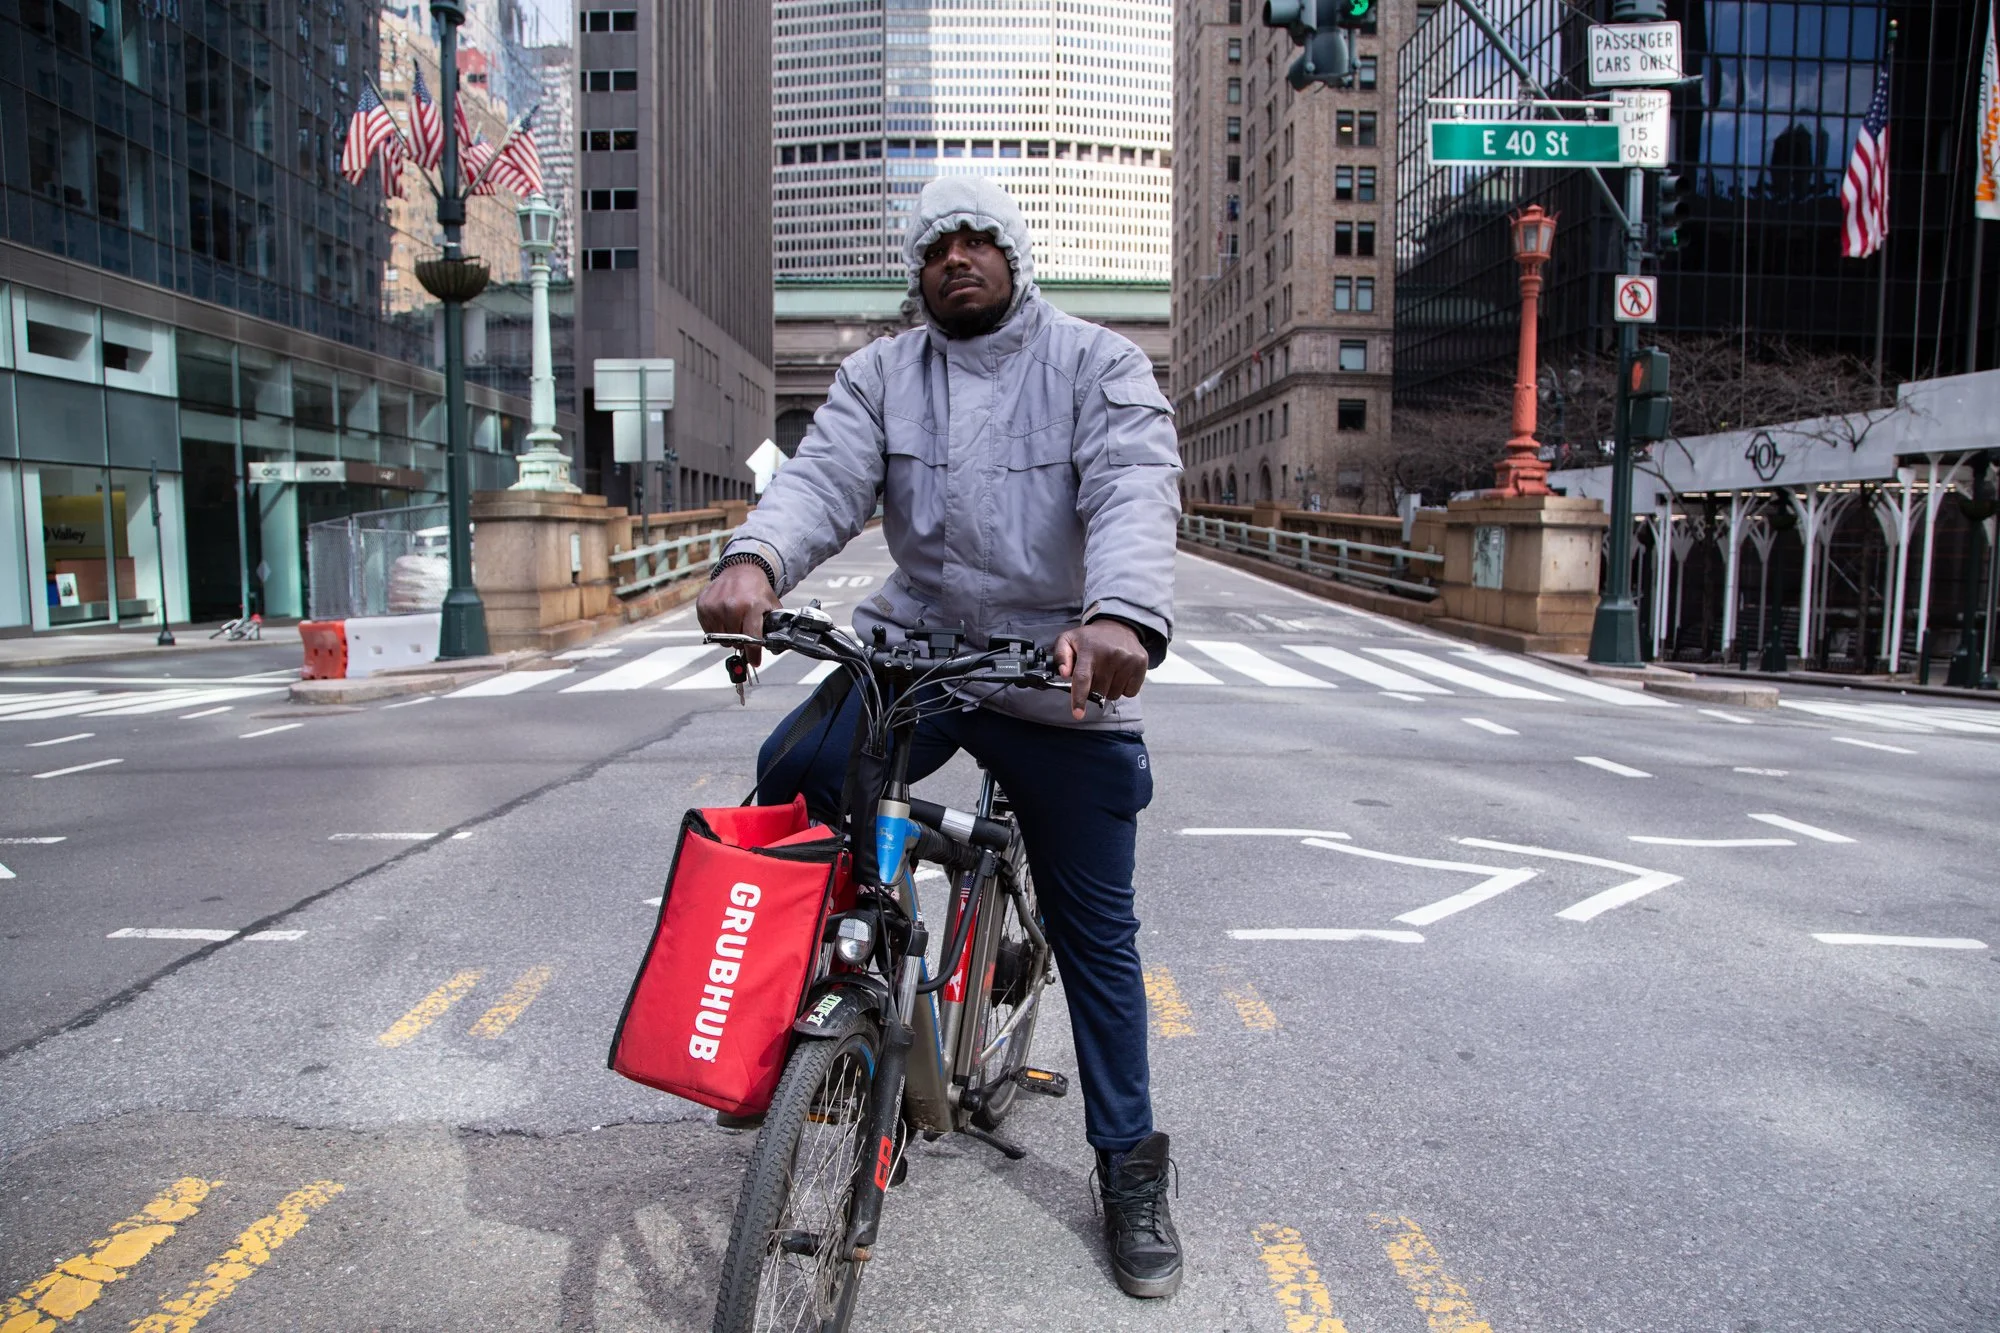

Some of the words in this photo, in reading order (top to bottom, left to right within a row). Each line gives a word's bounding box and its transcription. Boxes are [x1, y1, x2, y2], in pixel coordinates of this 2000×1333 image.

[1596, 32, 1673, 51] PASSENGER
[1596, 56, 1631, 73] CARS
[1640, 54, 1673, 71] ONLY
[1623, 111, 1656, 123] LIMIT
[1483, 129, 1497, 156] E
[1505, 129, 1537, 157] 40
[1545, 129, 1570, 157] St
[1630, 127, 1648, 141] 15
[51, 527, 86, 544] Valley
[688, 882, 762, 1063] GRUBHUB
[806, 994, 843, 1027] E-BIKE
